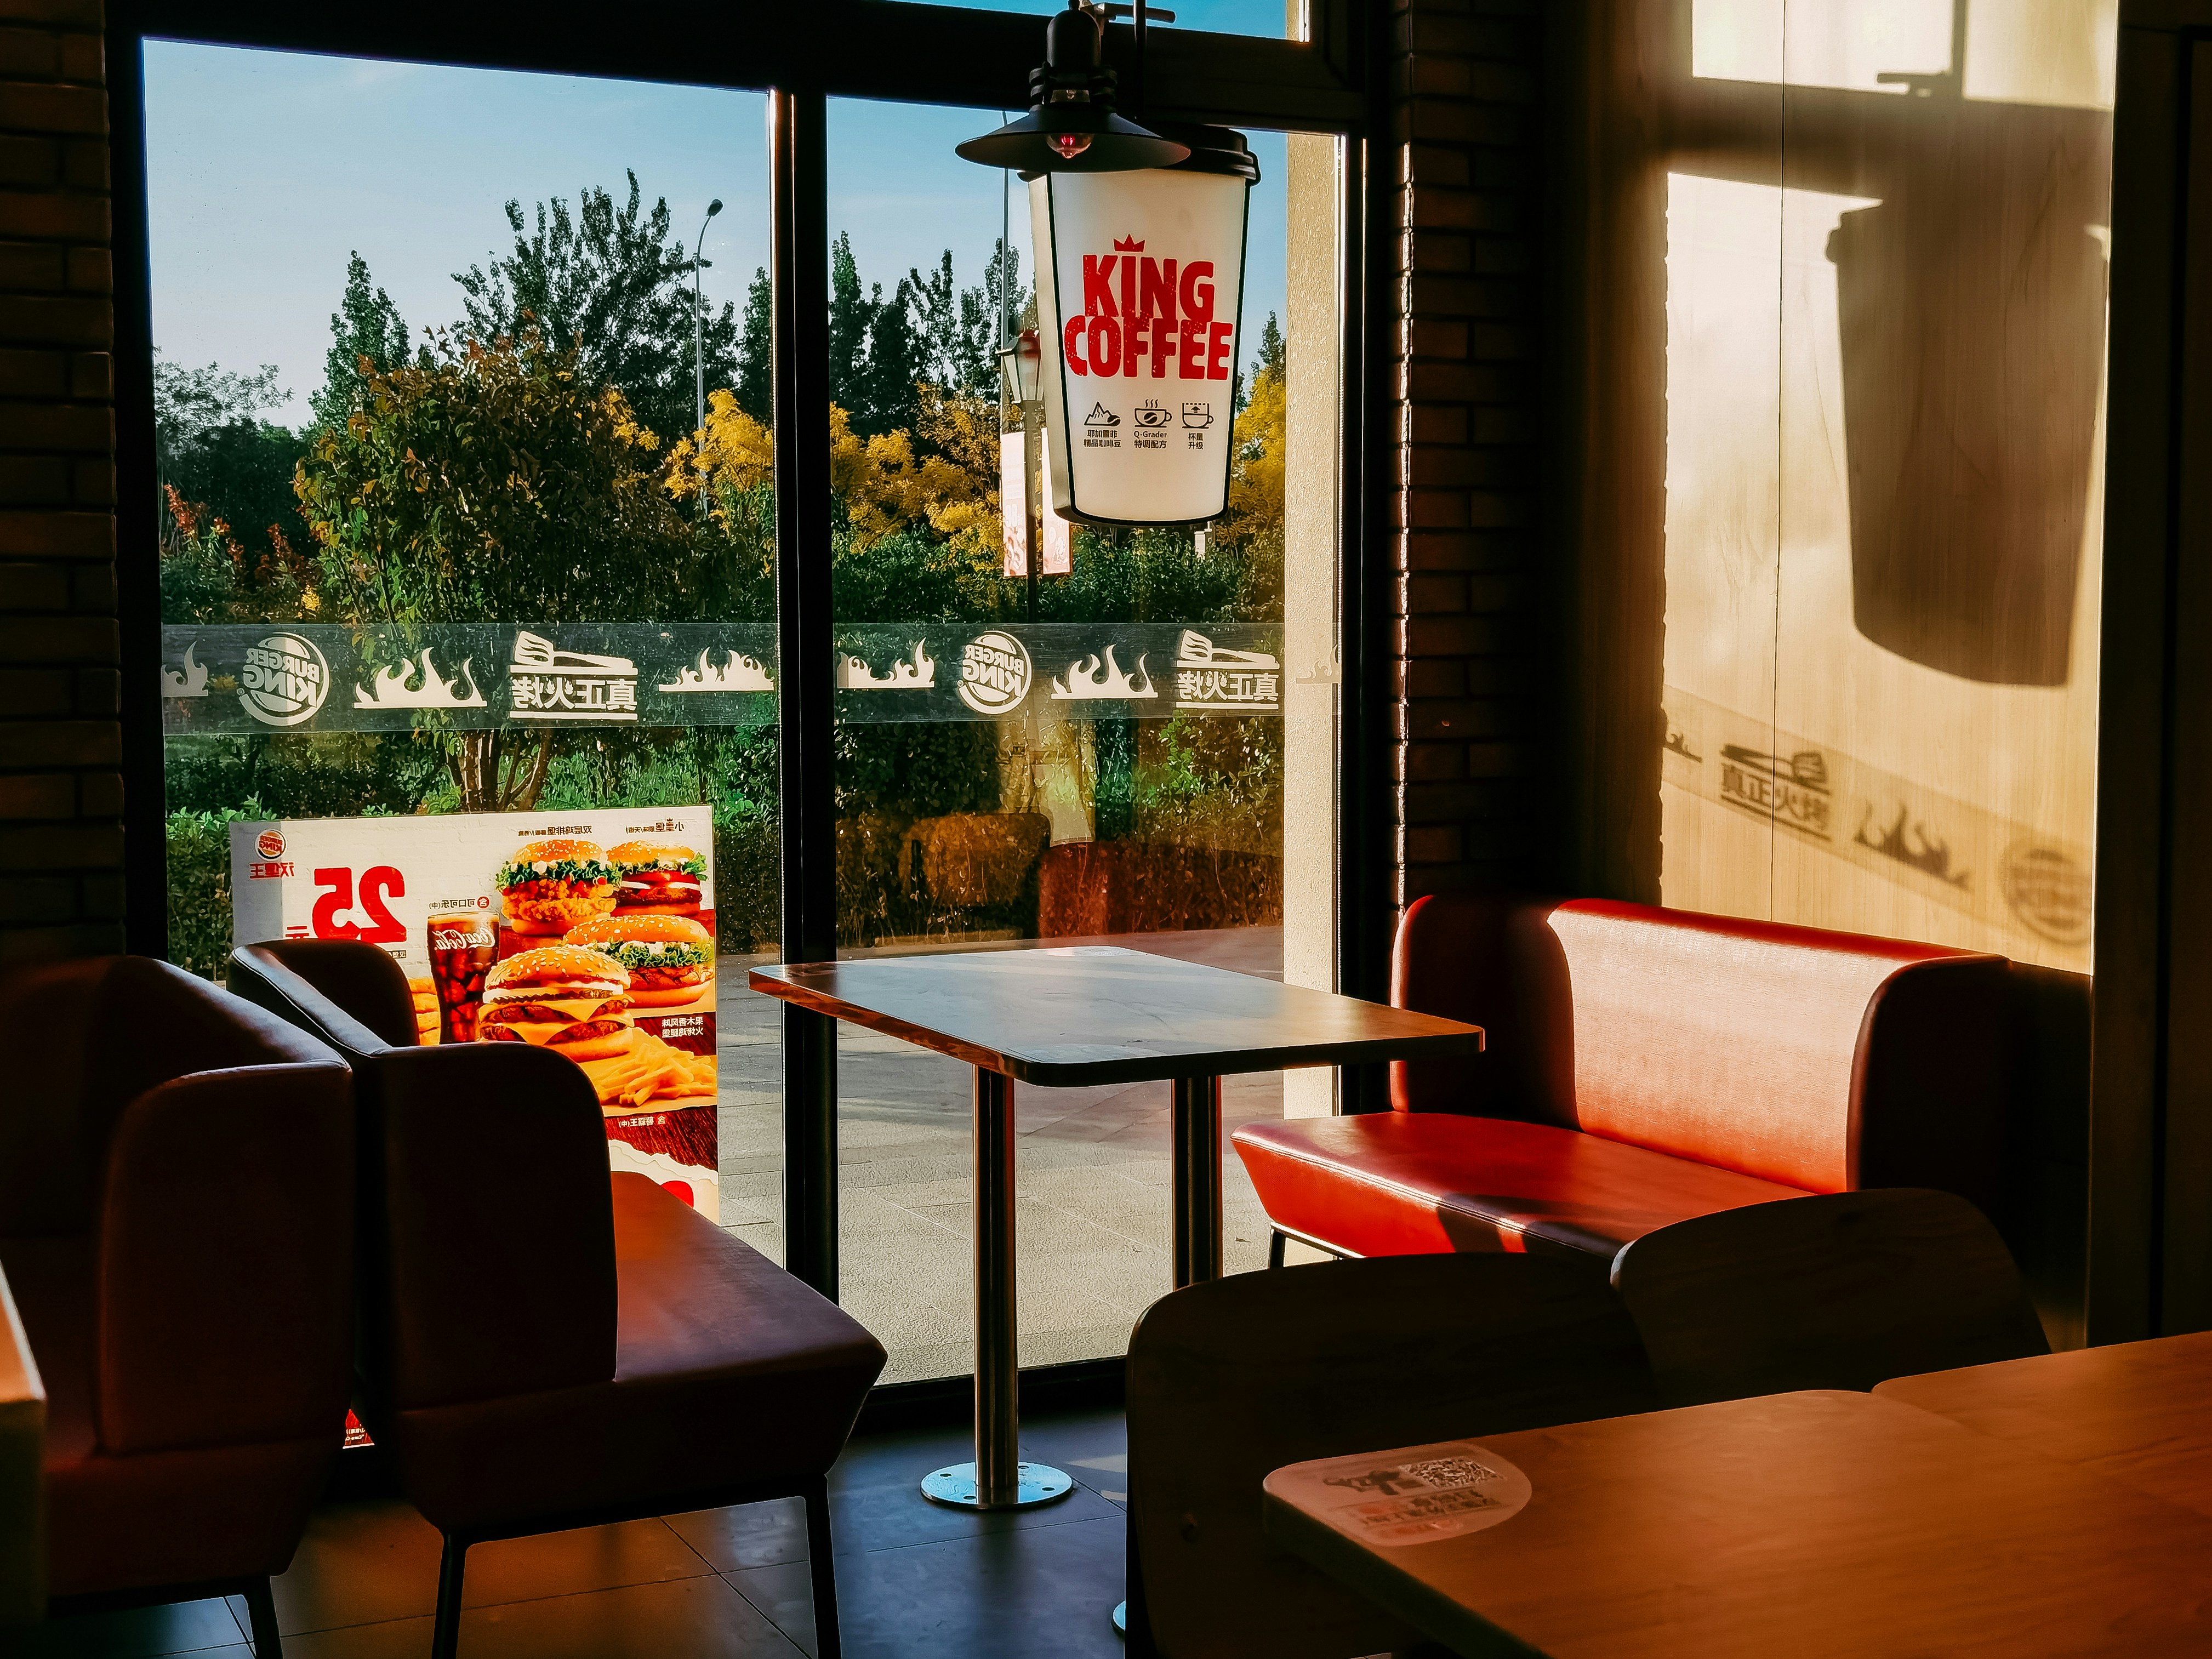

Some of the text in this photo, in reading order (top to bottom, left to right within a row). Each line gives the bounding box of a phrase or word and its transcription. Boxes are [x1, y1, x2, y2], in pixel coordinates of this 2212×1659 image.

[1082, 254, 1215, 322] KING
[1064, 315, 1233, 380] COFFEE
[1133, 440, 1167, 449] 特调配方
